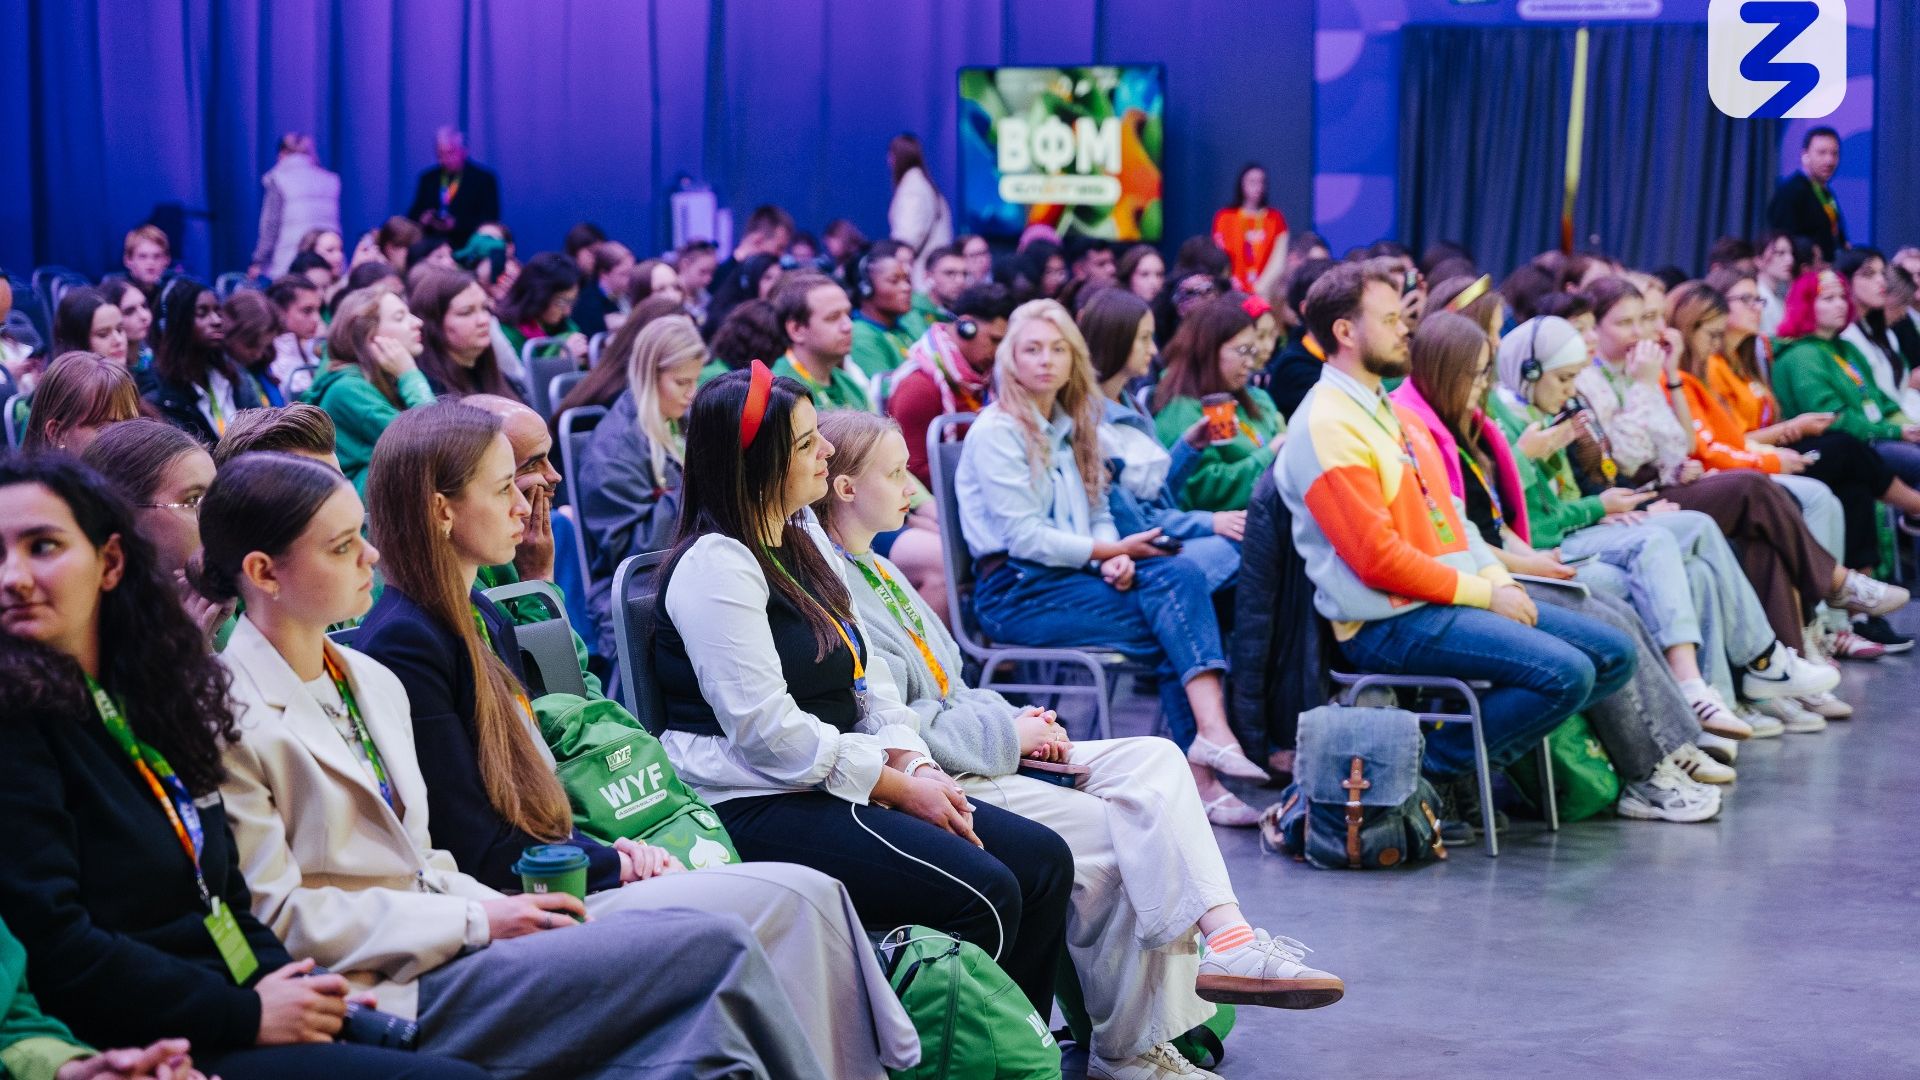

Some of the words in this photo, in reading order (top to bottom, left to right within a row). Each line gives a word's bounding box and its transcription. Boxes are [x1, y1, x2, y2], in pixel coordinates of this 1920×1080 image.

[997, 115, 1122, 174] ВФМ
[608, 748, 630, 765] WYF
[599, 762, 663, 808] WYF
